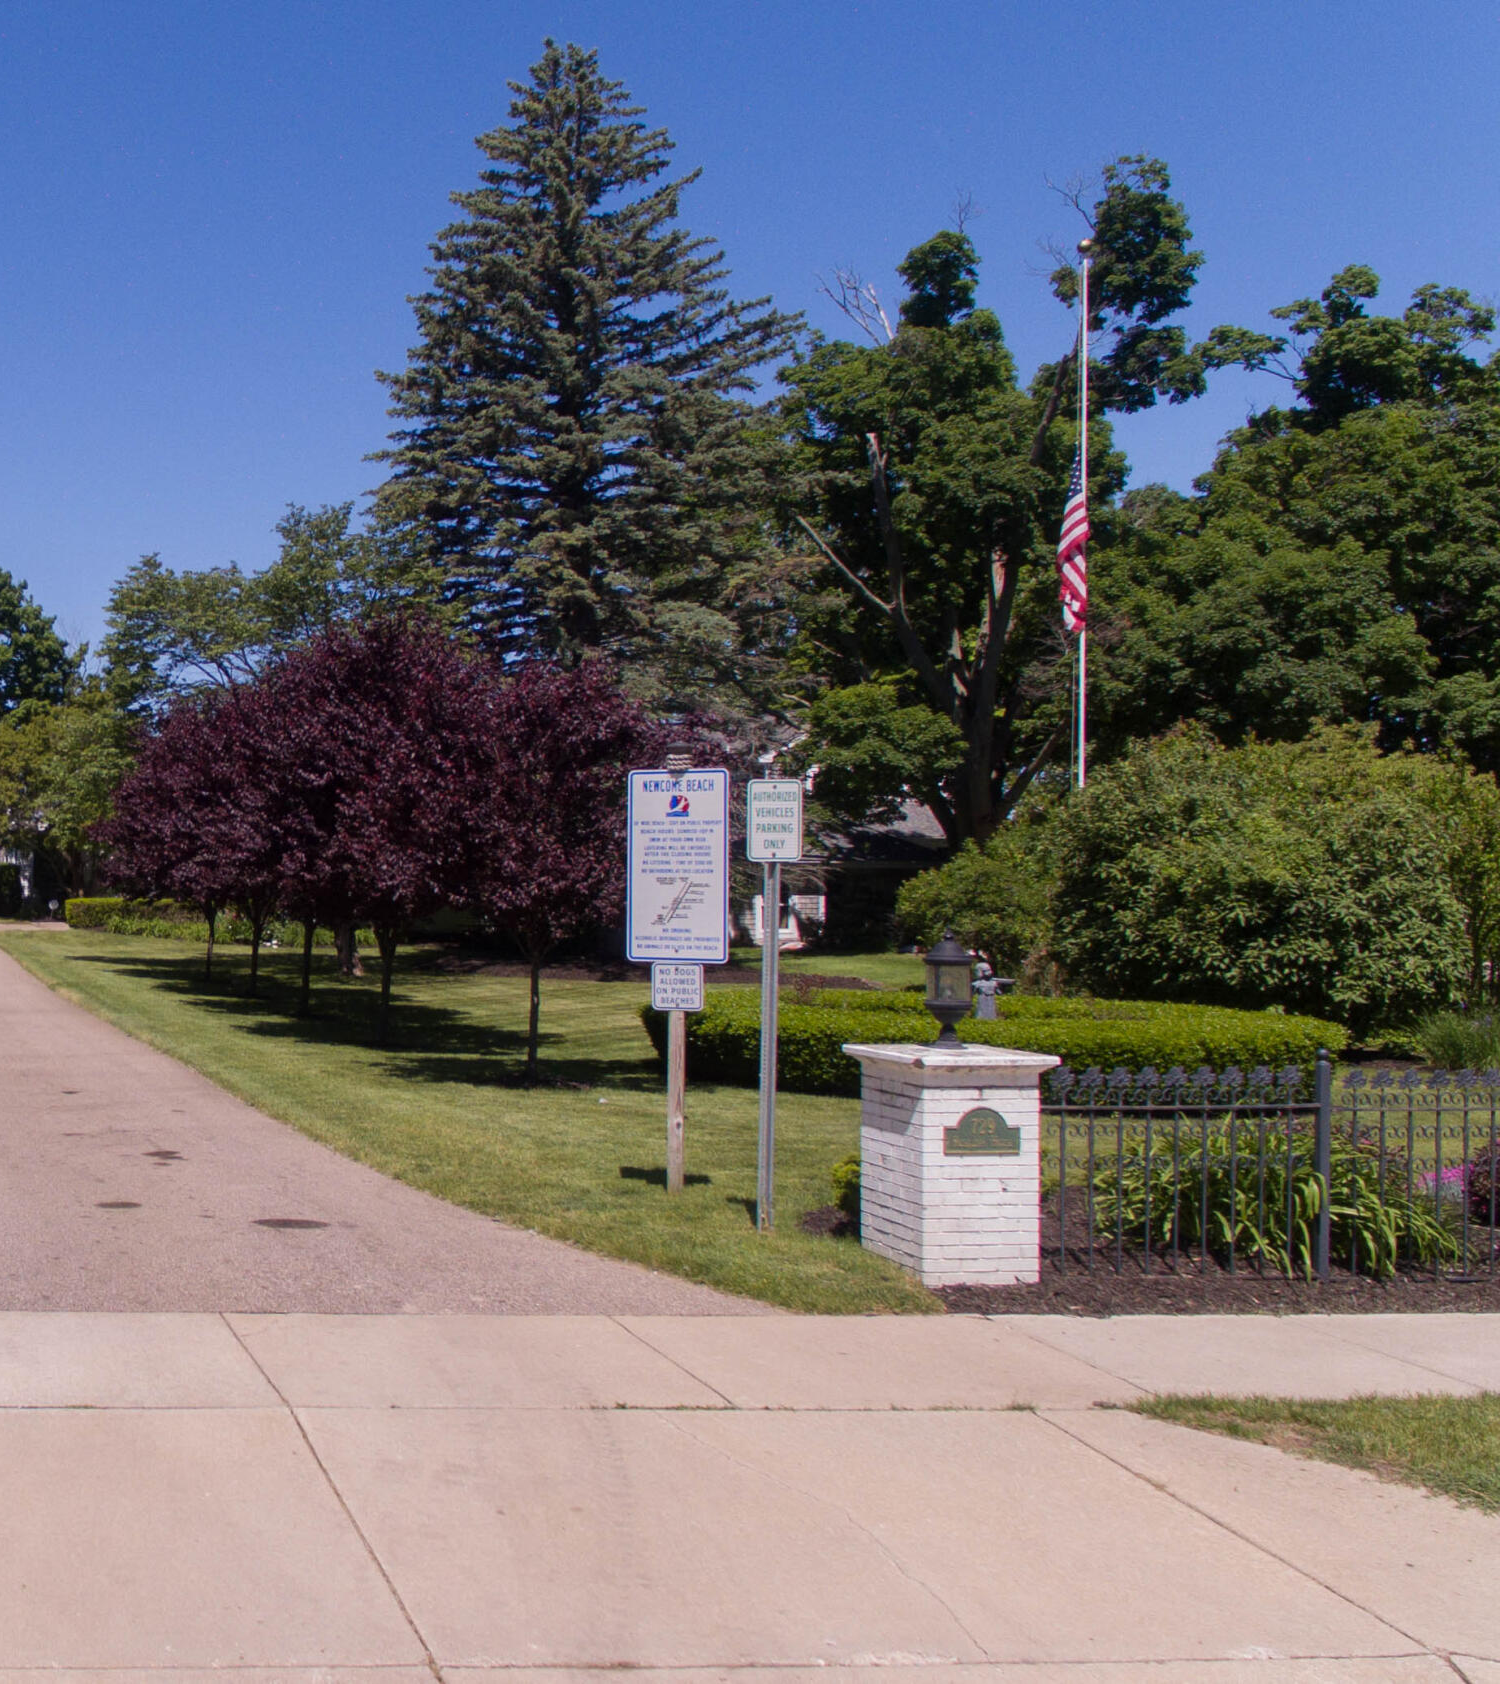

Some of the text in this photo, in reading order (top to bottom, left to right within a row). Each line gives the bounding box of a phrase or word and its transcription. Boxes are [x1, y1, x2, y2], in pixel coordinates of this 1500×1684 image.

[642, 779, 715, 793] NEWCOME BEACH
[753, 791, 798, 802] AUTHORIZED
[755, 807, 795, 818] VEHICLES
[755, 823, 794, 833] PARKING
[763, 839, 786, 849] ONLY
[659, 968, 671, 976] NO
[659, 977, 696, 985] ALLOWED
[671, 987, 699, 995] PUBLIC
[971, 1118, 996, 1135] 729
